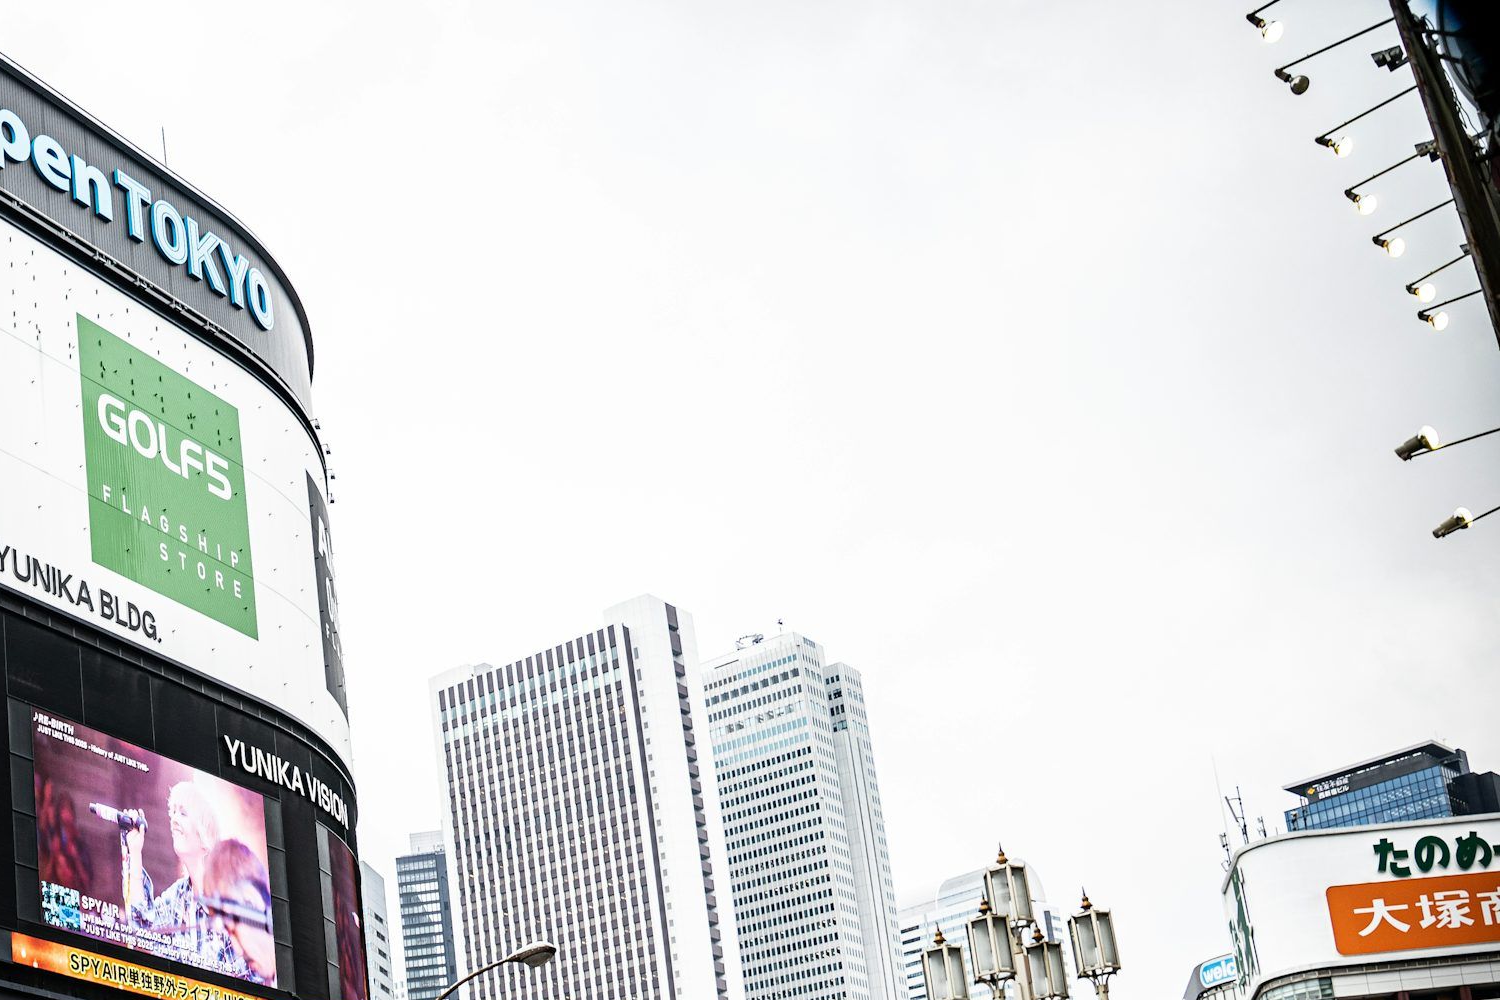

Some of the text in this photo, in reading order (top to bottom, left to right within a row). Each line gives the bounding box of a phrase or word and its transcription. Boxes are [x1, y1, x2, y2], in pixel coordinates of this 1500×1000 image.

[113, 168, 276, 332] TOKYO
[96, 393, 232, 501] GOLF5
[102, 485, 240, 569] FLAGSHIP
[159, 540, 244, 600] STORE
[99, 591, 163, 645] BLDG.
[223, 735, 350, 831] YUNIKA VISION
[1373, 831, 1500, 878] たのめ
[81, 895, 120, 919] SPYAIR
